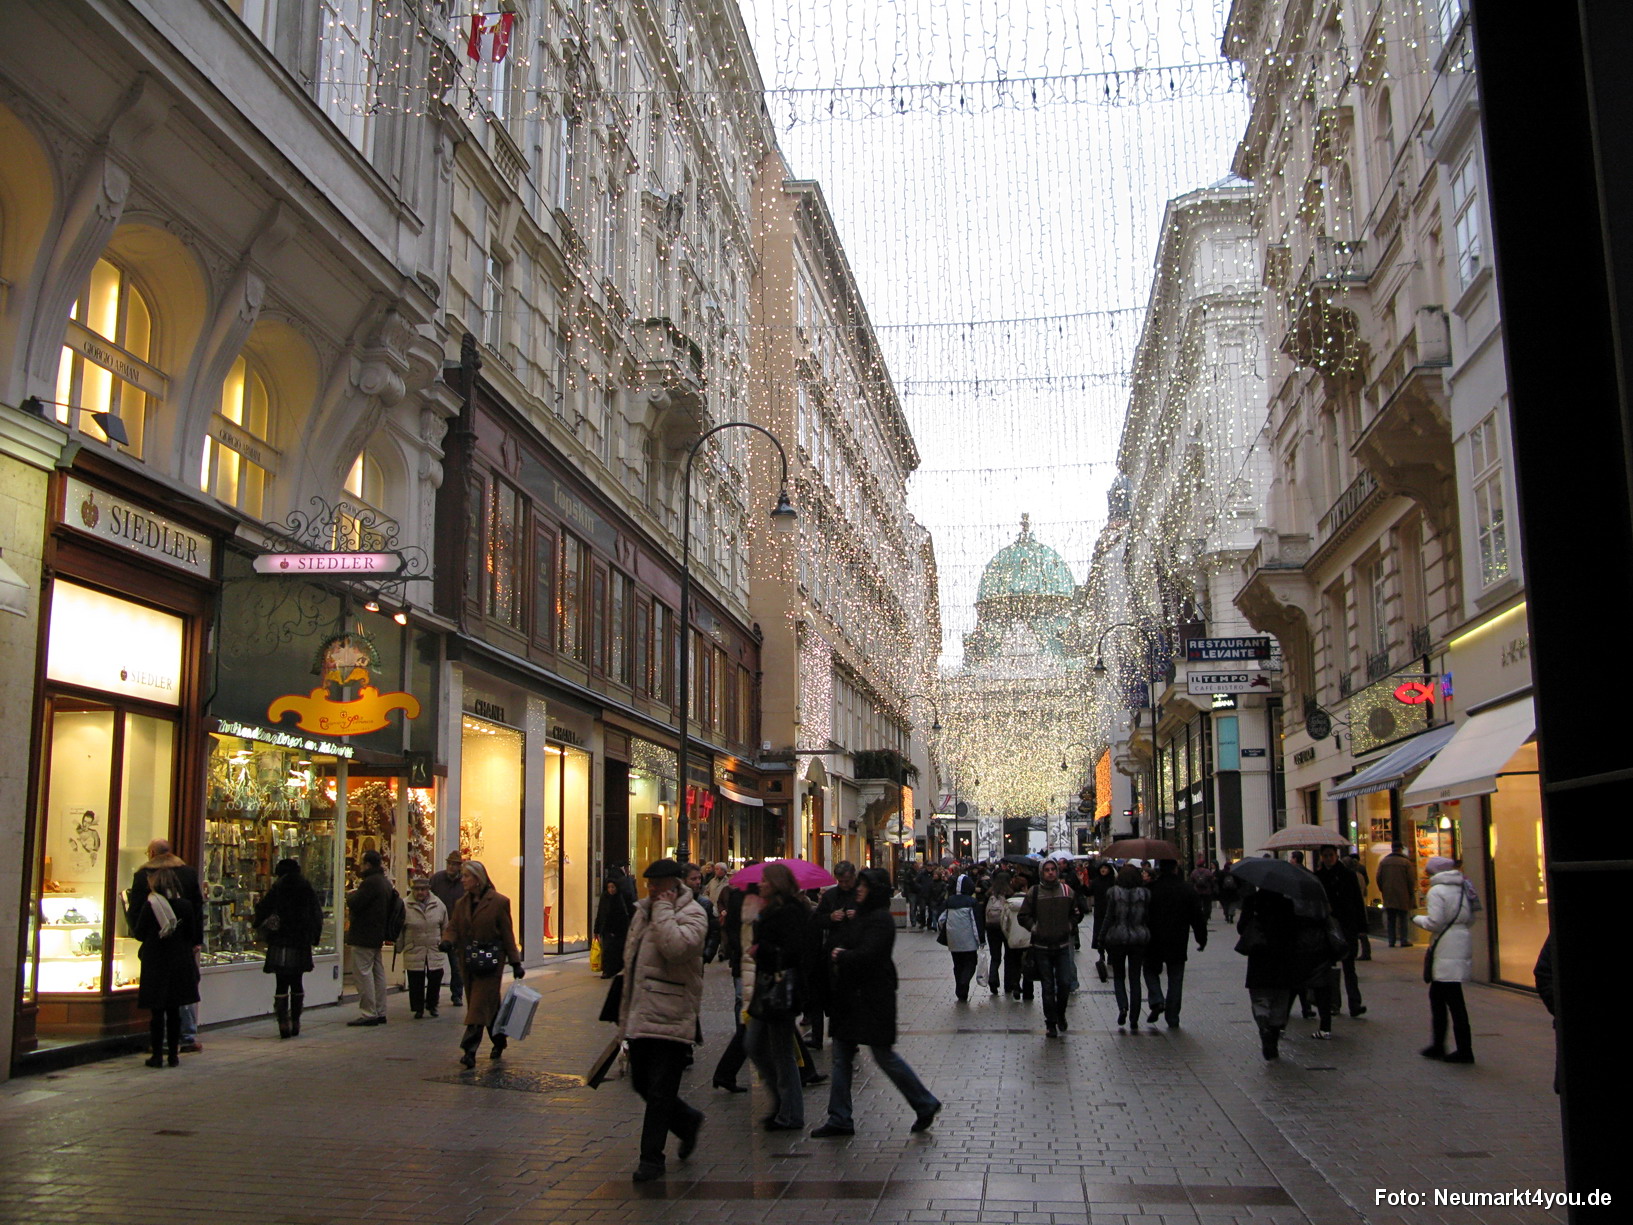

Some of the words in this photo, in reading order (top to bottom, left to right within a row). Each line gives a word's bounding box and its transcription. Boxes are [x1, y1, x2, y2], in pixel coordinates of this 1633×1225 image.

[83, 341, 113, 367] GIORGIO
[115, 360, 140, 383] ARMANI
[219, 429, 242, 450] GIORGIO
[109, 504, 199, 567] SIEDLER
[297, 557, 375, 570] SIEDLER
[1189, 639, 1267, 649] RESTAURANT
[1202, 649, 1255, 659] LEVANTE
[131, 671, 172, 690] SIEDLER
[1203, 675, 1247, 683] TEMPO
